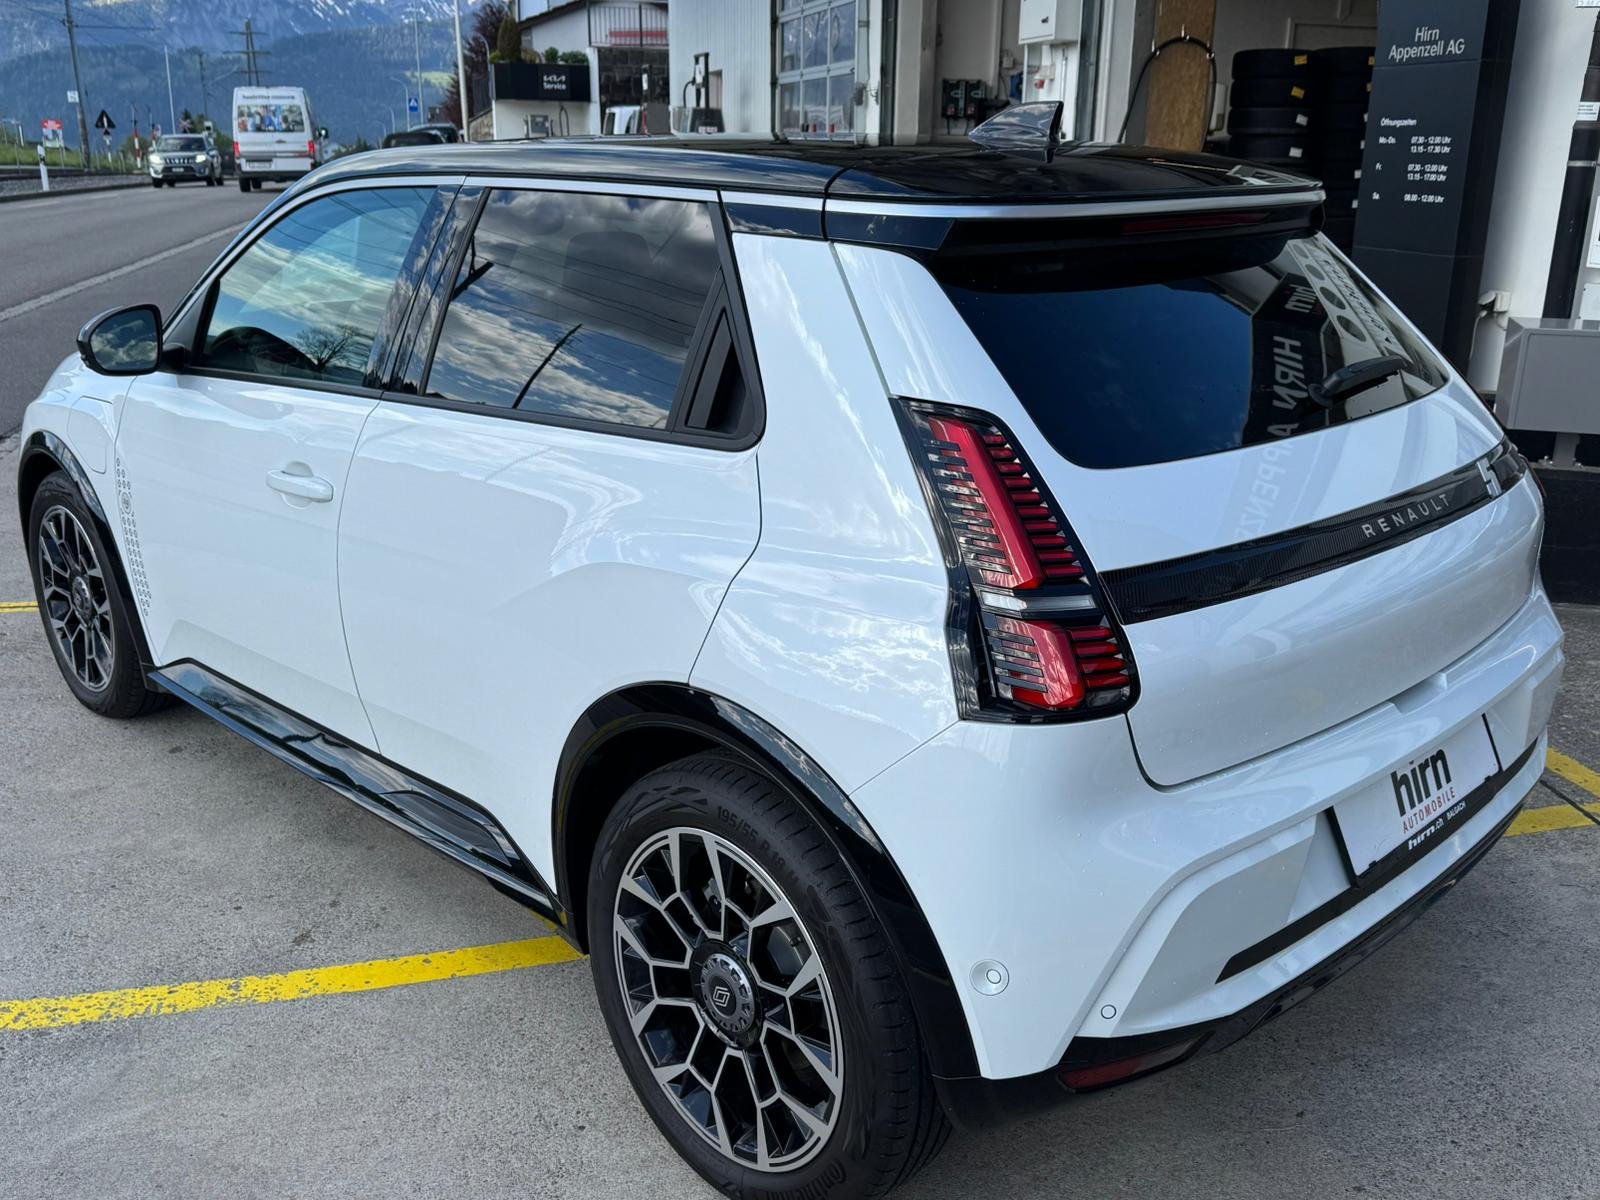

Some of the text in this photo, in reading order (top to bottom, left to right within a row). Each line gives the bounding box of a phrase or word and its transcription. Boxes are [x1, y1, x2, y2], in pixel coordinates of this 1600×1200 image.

[1414, 26, 1440, 42] Hirn
[1388, 38, 1465, 63] Appenzell AG
[543, 82, 567, 90] Service
[1441, 136, 1452, 144] Uhr
[1441, 145, 1451, 153] Uhr
[1437, 164, 1448, 172] Uhr
[1434, 195, 1445, 203] Uhr
[1361, 493, 1451, 538] RENAULT
[1390, 748, 1452, 818] hirn
[1402, 786, 1456, 834] AUTOMOBILE
[716, 805, 758, 840] 195/55
[759, 839, 772, 857] R
[1408, 818, 1445, 850] hirn.ch
